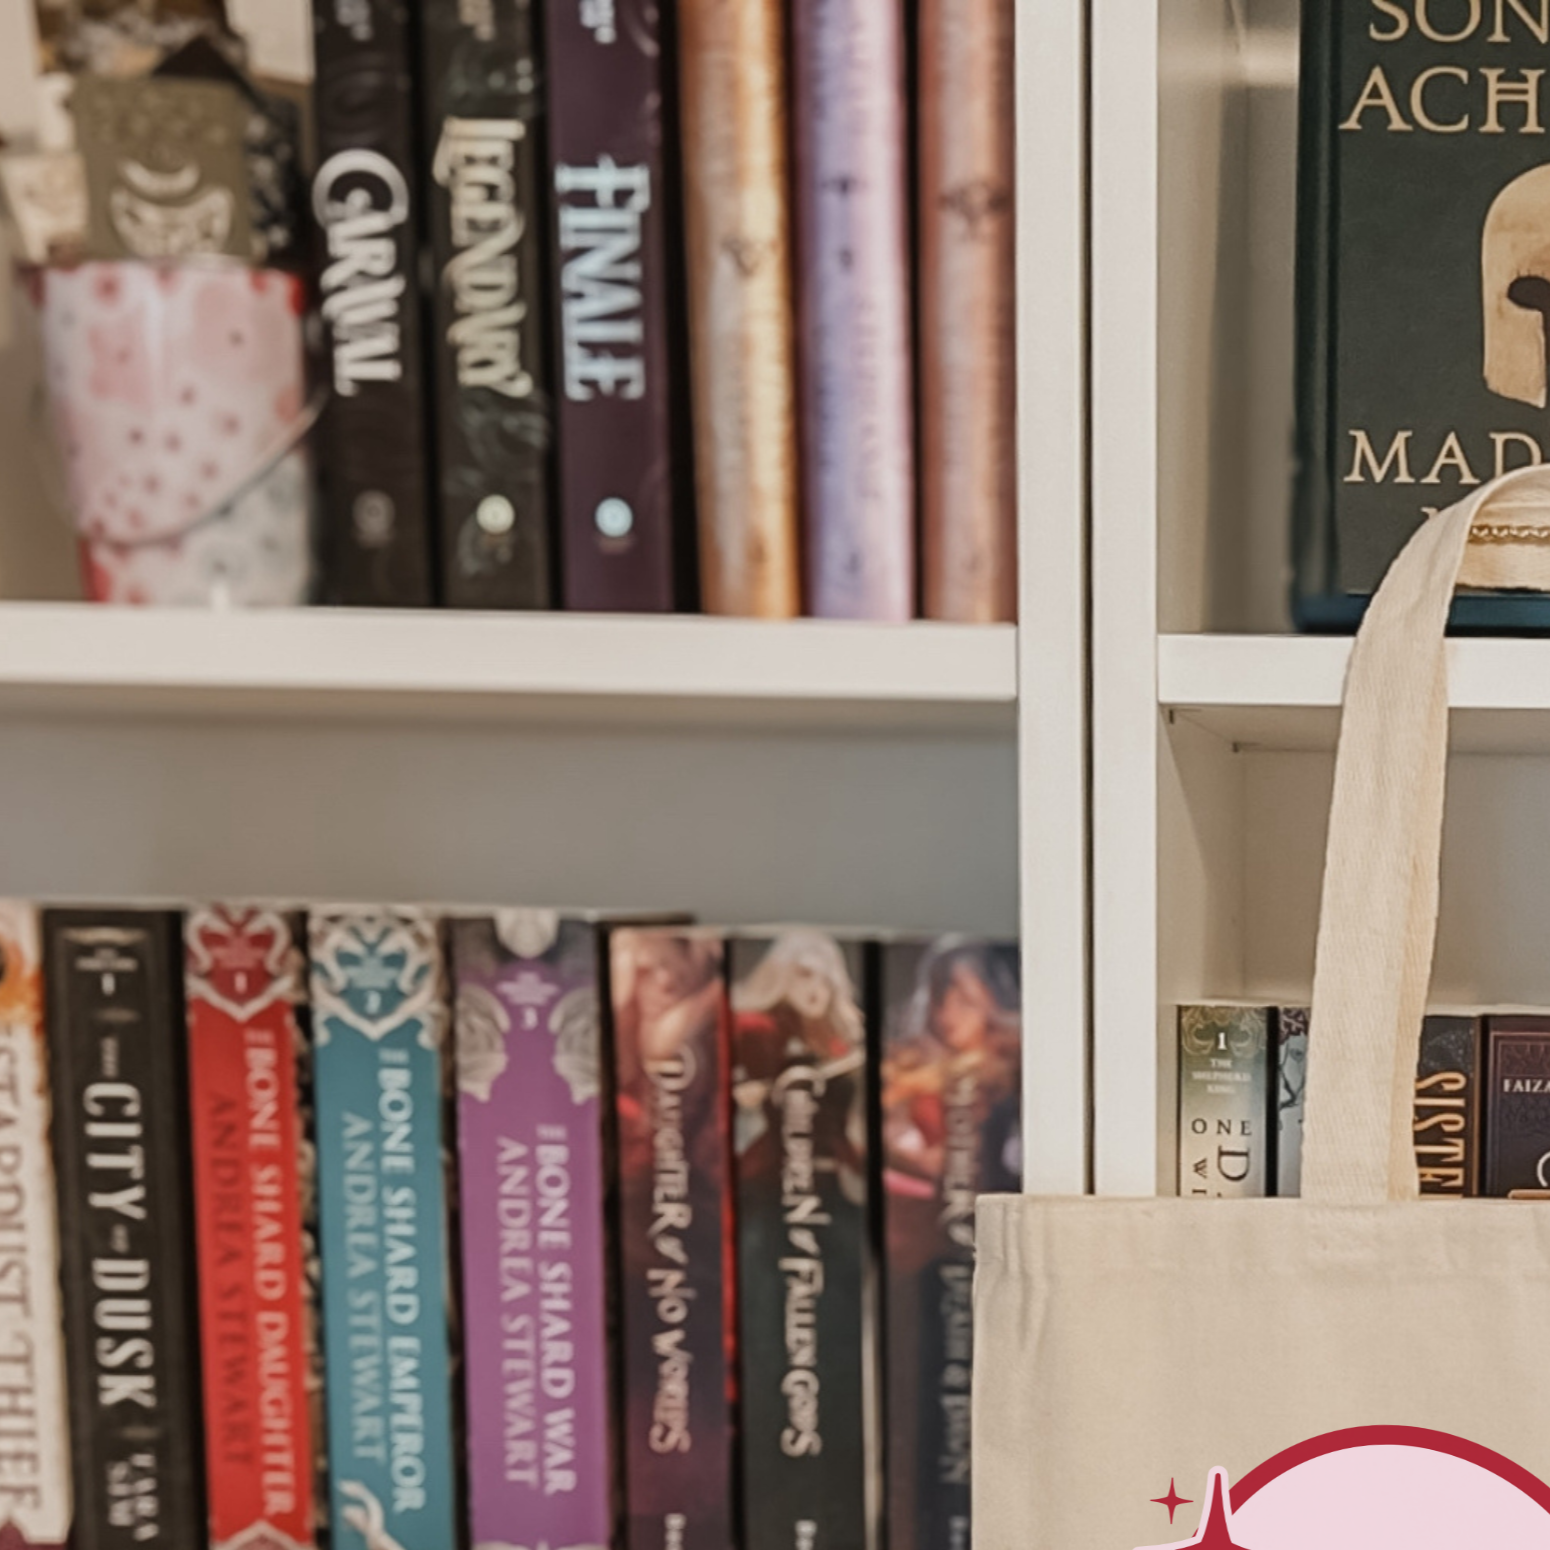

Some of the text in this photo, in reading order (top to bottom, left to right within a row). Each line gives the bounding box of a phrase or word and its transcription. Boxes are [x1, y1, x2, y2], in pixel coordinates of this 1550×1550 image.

[554, 155, 652, 401] FINALE
[83, 1081, 157, 1408] CITY DUSK
[245, 1047, 296, 1516] BONE SHARD DAUGHTER
[341, 1110, 387, 1467] ANDREA STEWART
[378, 1067, 427, 1514] BONE SHARD EMPEROR
[1191, 1118, 1253, 1137] ONE
[497, 1134, 539, 1491] ANDREA STEWART
[535, 1144, 578, 1497] BONE SHARD WAR
